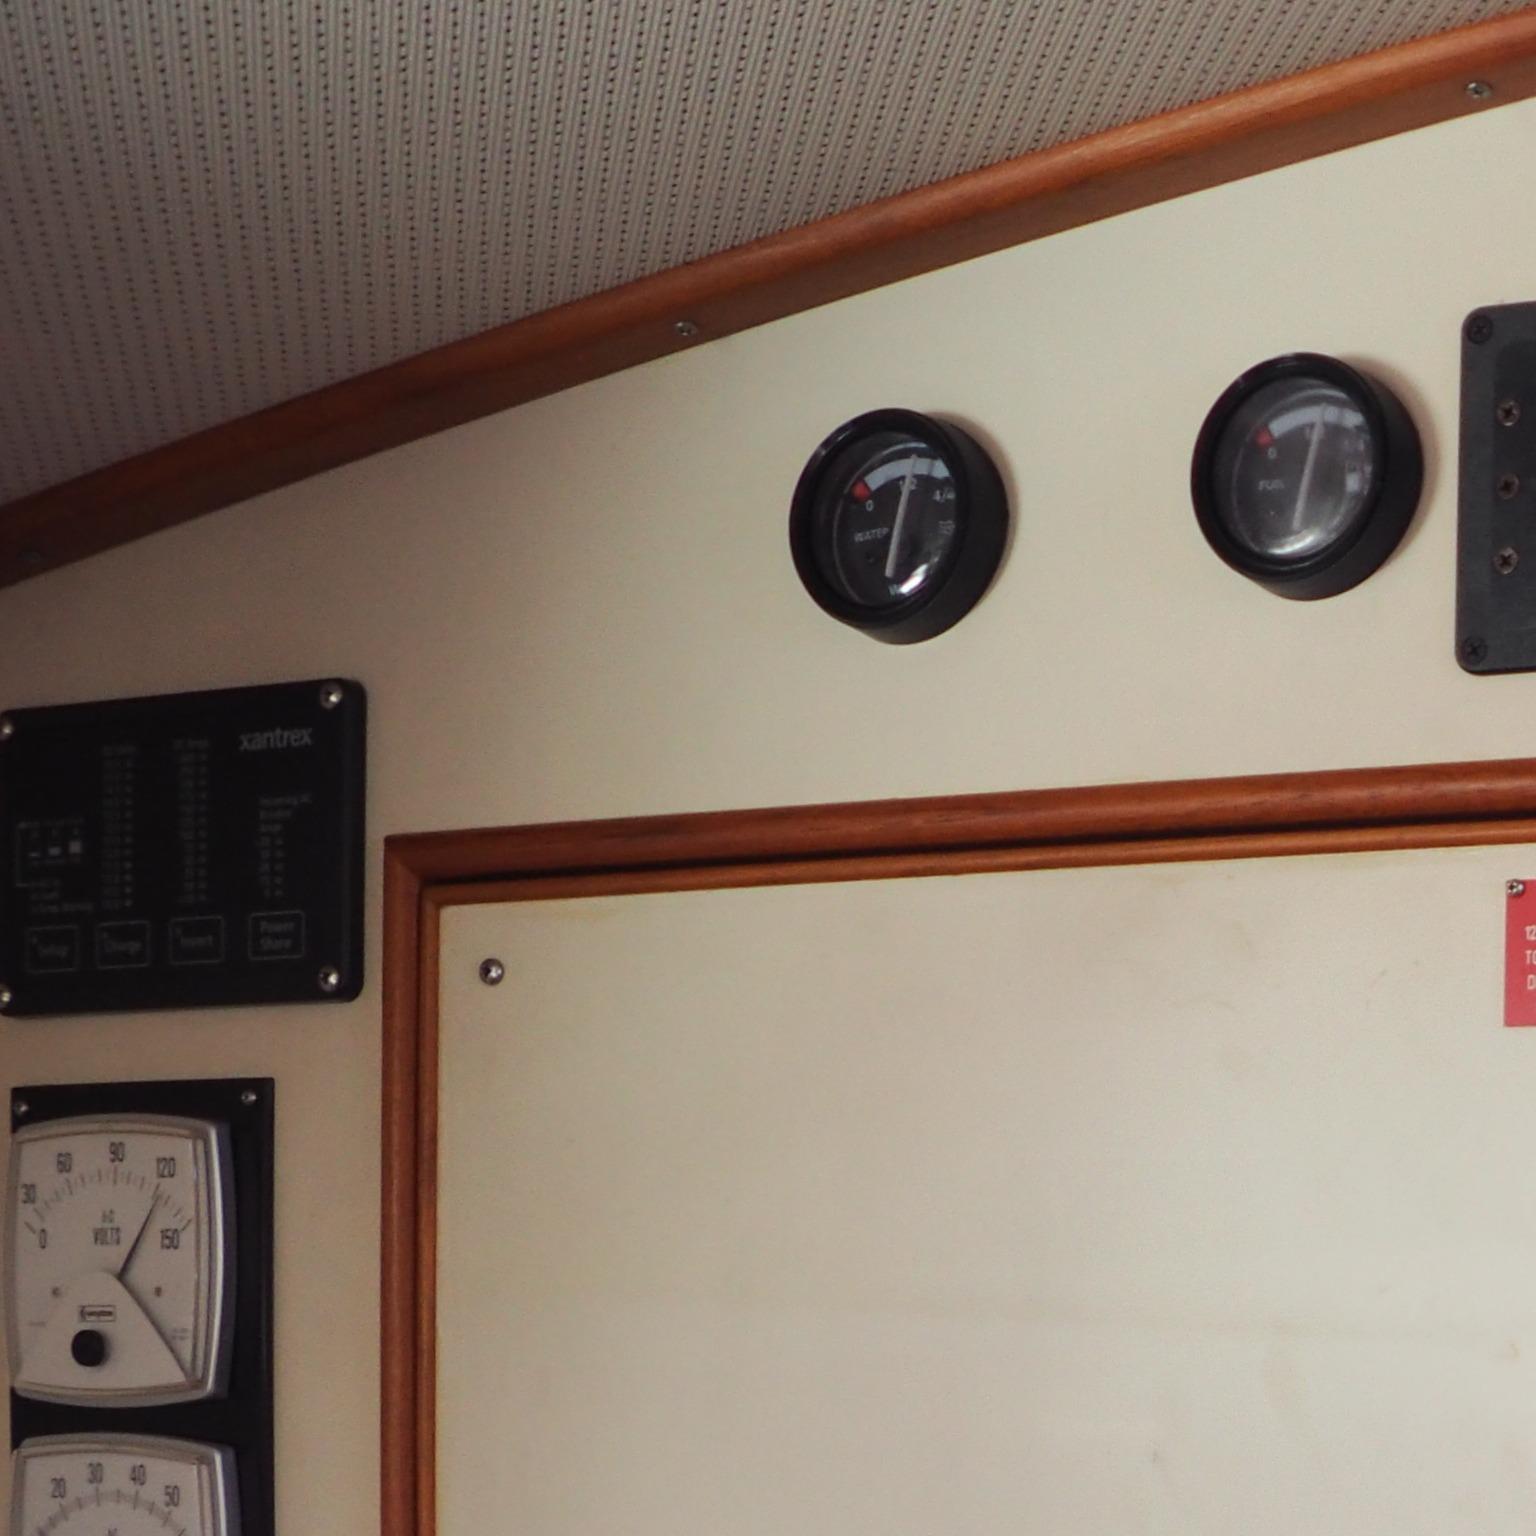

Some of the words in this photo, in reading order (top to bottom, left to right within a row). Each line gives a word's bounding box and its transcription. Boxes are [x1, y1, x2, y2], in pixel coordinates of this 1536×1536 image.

[239, 728, 312, 751] xantrex
[57, 1152, 73, 1173] 60
[109, 1141, 125, 1163] 90
[156, 1156, 176, 1179] 120
[21, 1184, 36, 1205] 30
[39, 1228, 47, 1250] 0
[93, 1227, 121, 1246] VOLTS
[160, 1229, 180, 1250] 150
[88, 1462, 104, 1484] 30
[130, 1464, 147, 1486] 40
[51, 1477, 66, 1499] 20
[164, 1485, 181, 1508] 50
